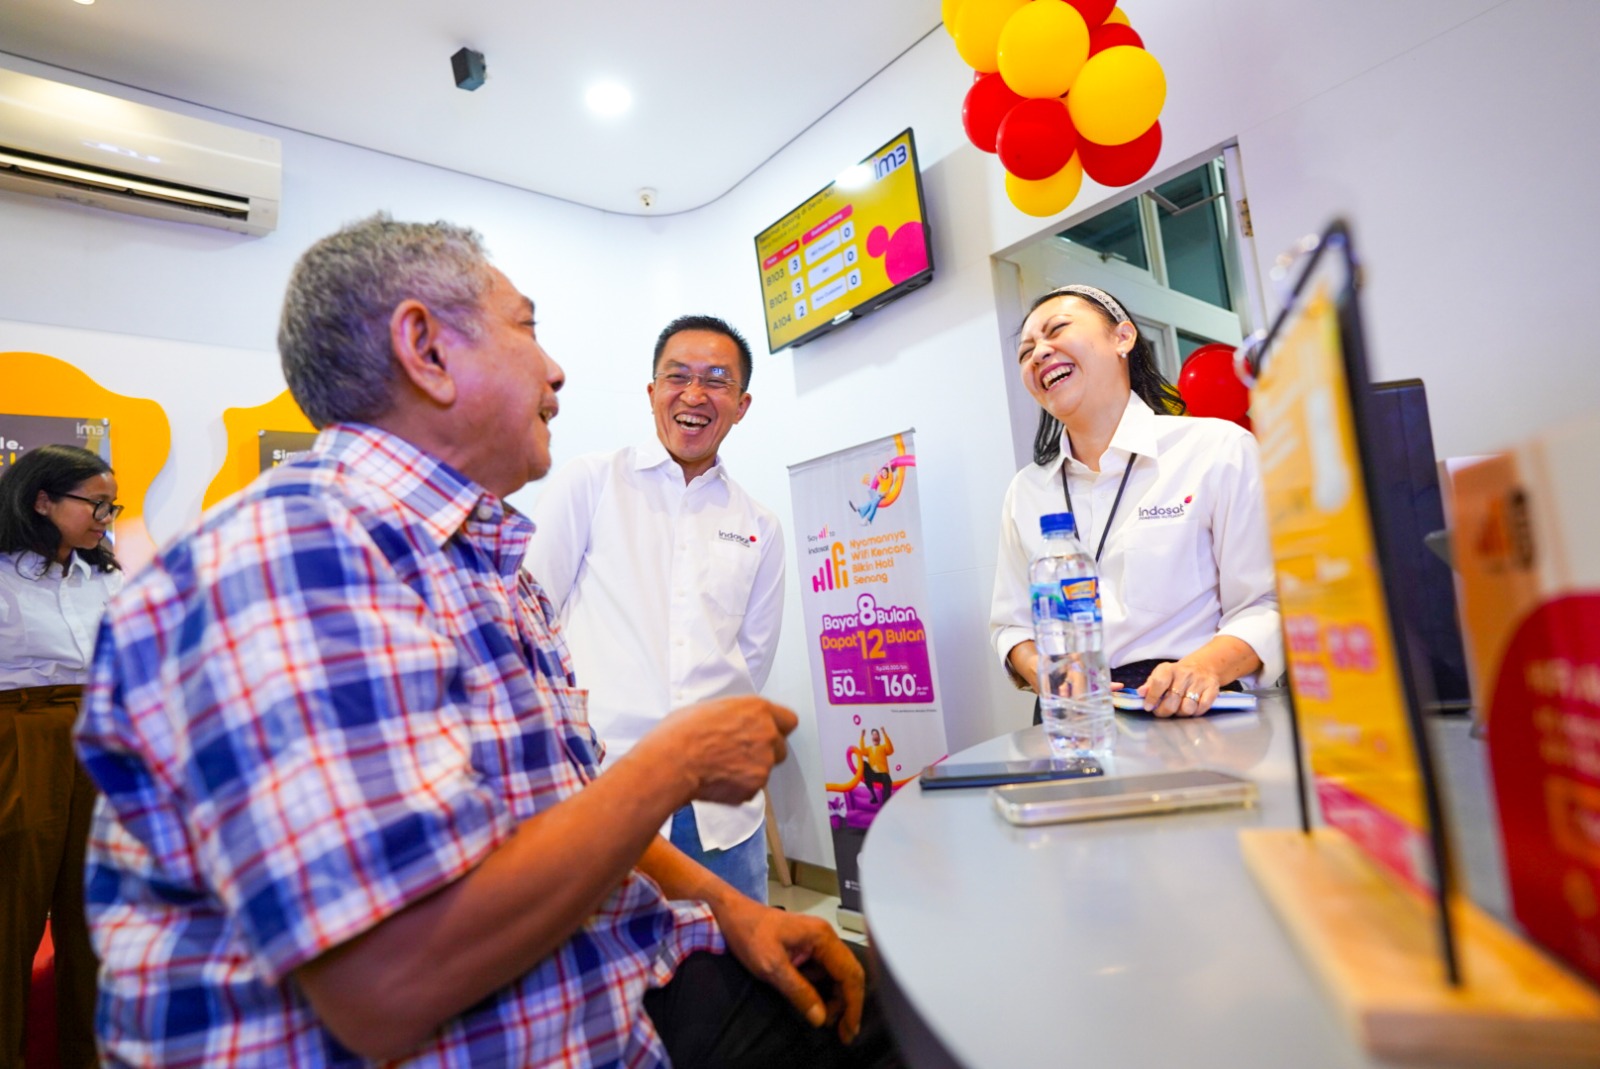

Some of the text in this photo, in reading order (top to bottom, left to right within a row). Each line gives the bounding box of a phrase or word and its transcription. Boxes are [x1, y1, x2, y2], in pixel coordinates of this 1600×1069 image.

[843, 227, 851, 238] 0
[847, 251, 854, 262] 0
[793, 259, 799, 270] 3
[767, 268, 785, 286] B103
[850, 275, 858, 286] 0
[796, 282, 802, 293] 3
[769, 291, 788, 309] B102
[799, 305, 805, 317] 2
[773, 314, 792, 331] A104
[1138, 503, 1184, 516] Indosat
[849, 530, 906, 549] Nyamannya
[852, 557, 894, 573] Bikin Hati
[853, 573, 888, 585] Senang
[823, 594, 916, 632] Bayar 8 Bulan
[821, 628, 925, 660] Dapat 12 Bulan
[832, 675, 855, 697] 50
